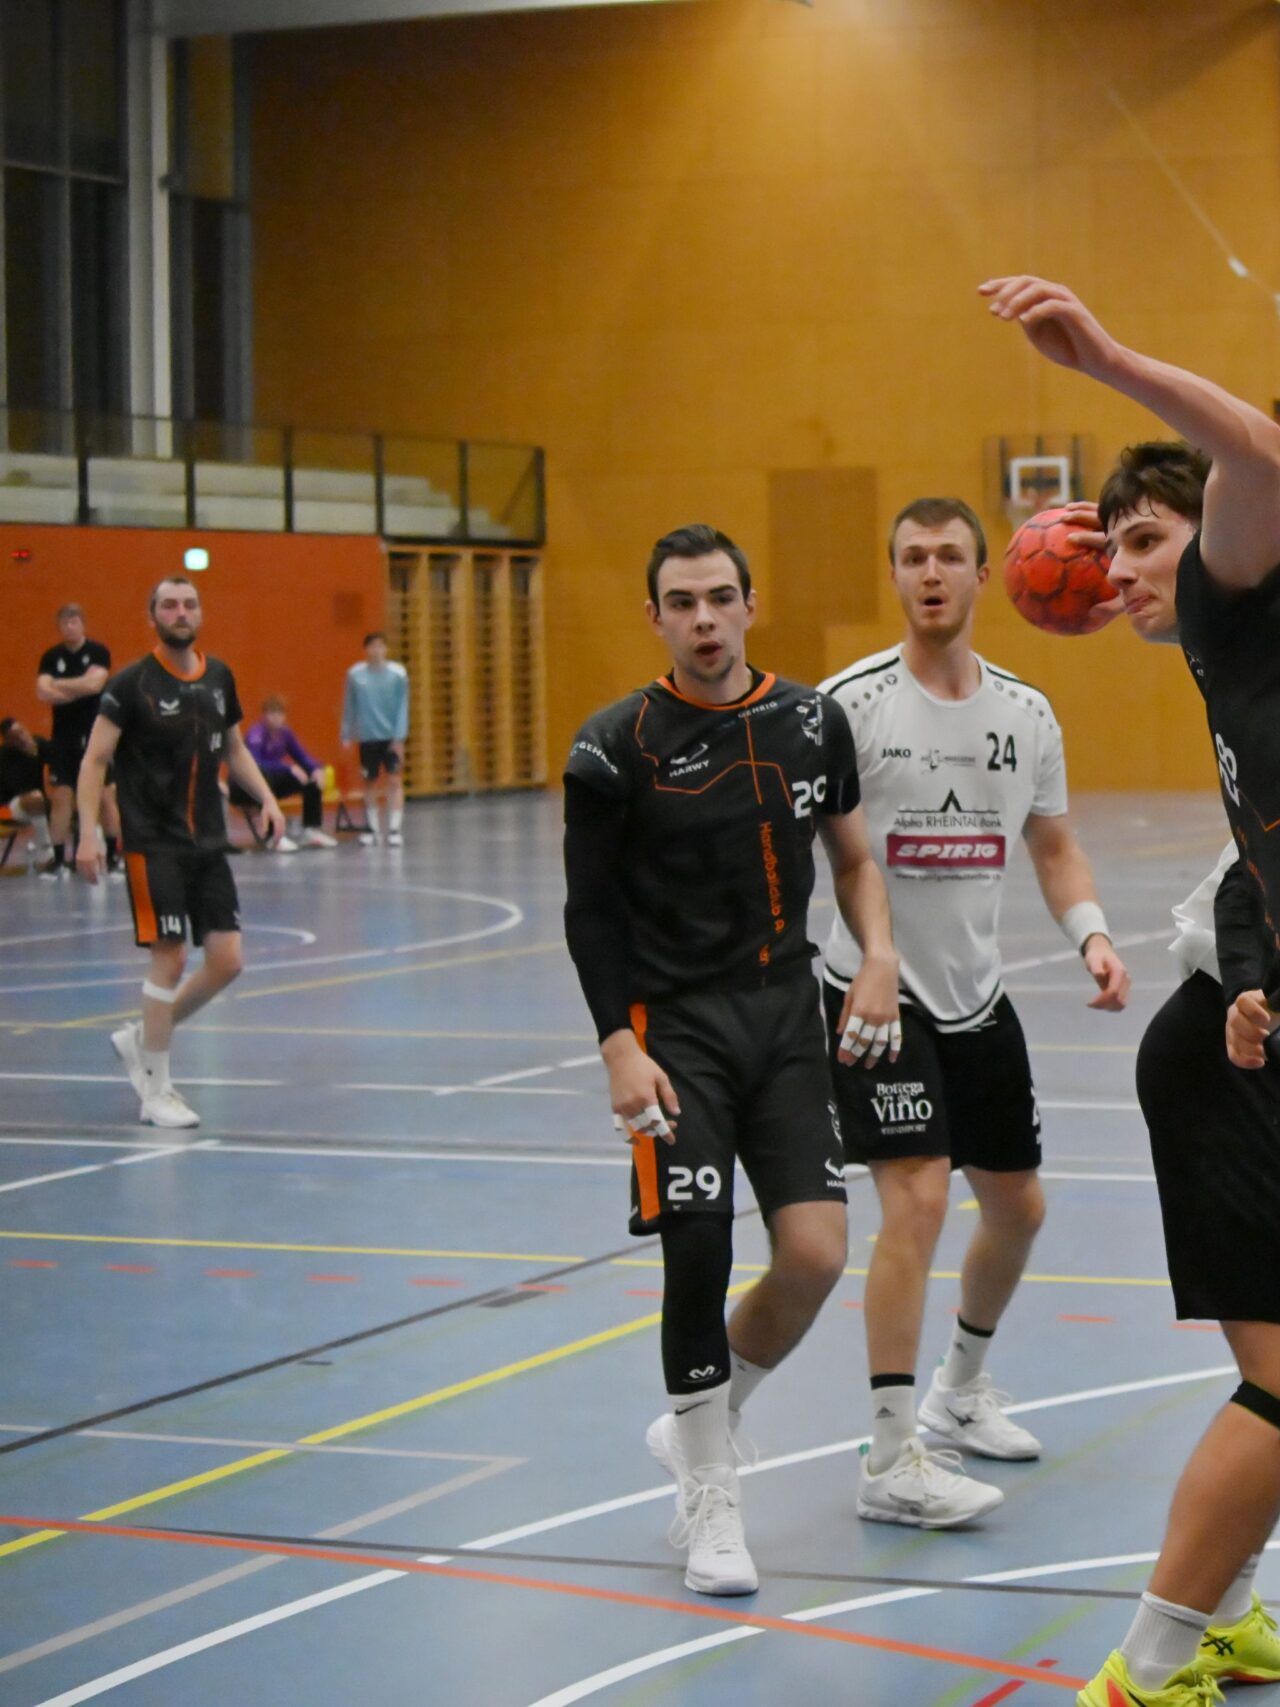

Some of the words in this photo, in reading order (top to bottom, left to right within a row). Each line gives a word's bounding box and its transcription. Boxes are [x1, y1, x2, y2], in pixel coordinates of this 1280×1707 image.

[880, 748, 912, 759] JAKO
[985, 731, 1017, 773] 24
[669, 759, 711, 778] HARWY
[926, 815, 977, 828] RHEINTAL
[980, 817, 1002, 828] Bank
[896, 843, 999, 859] SPIRIG
[160, 915, 183, 935] 14
[876, 1081, 925, 1097] Bottega
[870, 1095, 933, 1123] Vino
[666, 1166, 722, 1200] 29
